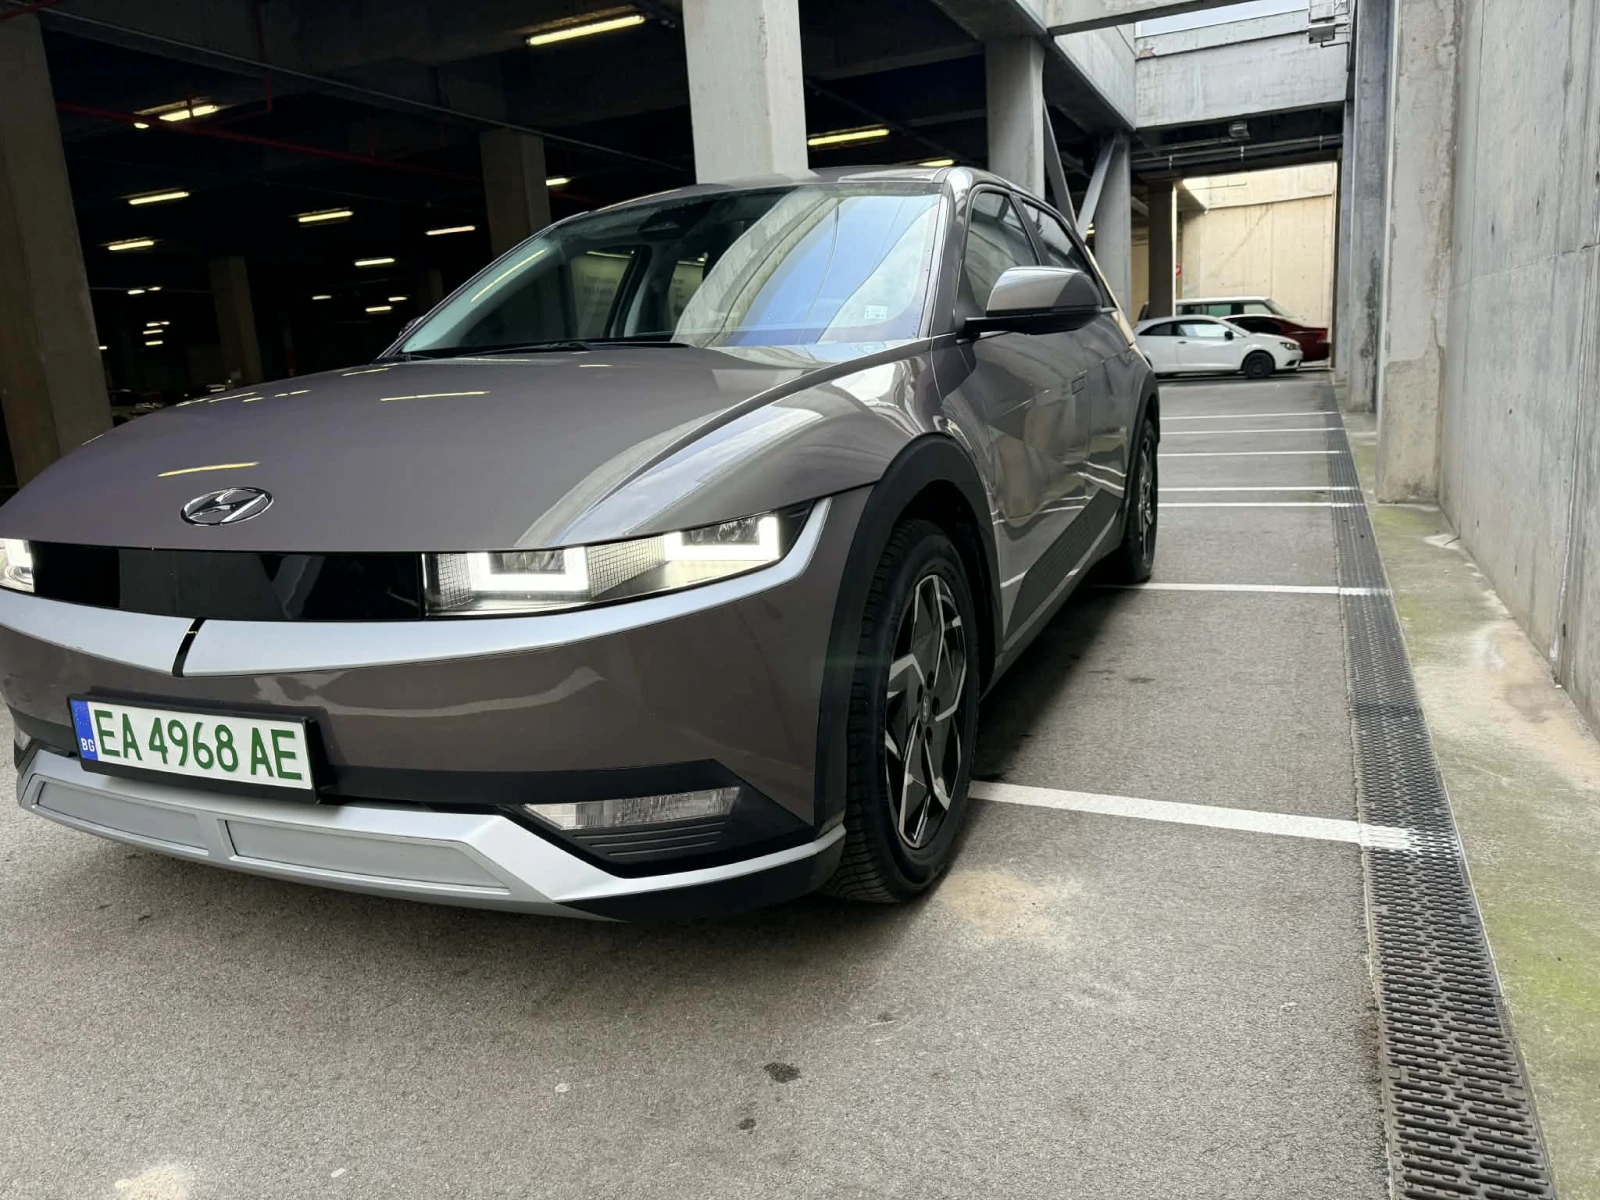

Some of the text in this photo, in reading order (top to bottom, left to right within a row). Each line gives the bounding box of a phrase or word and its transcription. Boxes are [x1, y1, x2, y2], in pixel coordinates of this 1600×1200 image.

[81, 738, 95, 752] BG
[94, 709, 303, 780] EA 4968 AE
